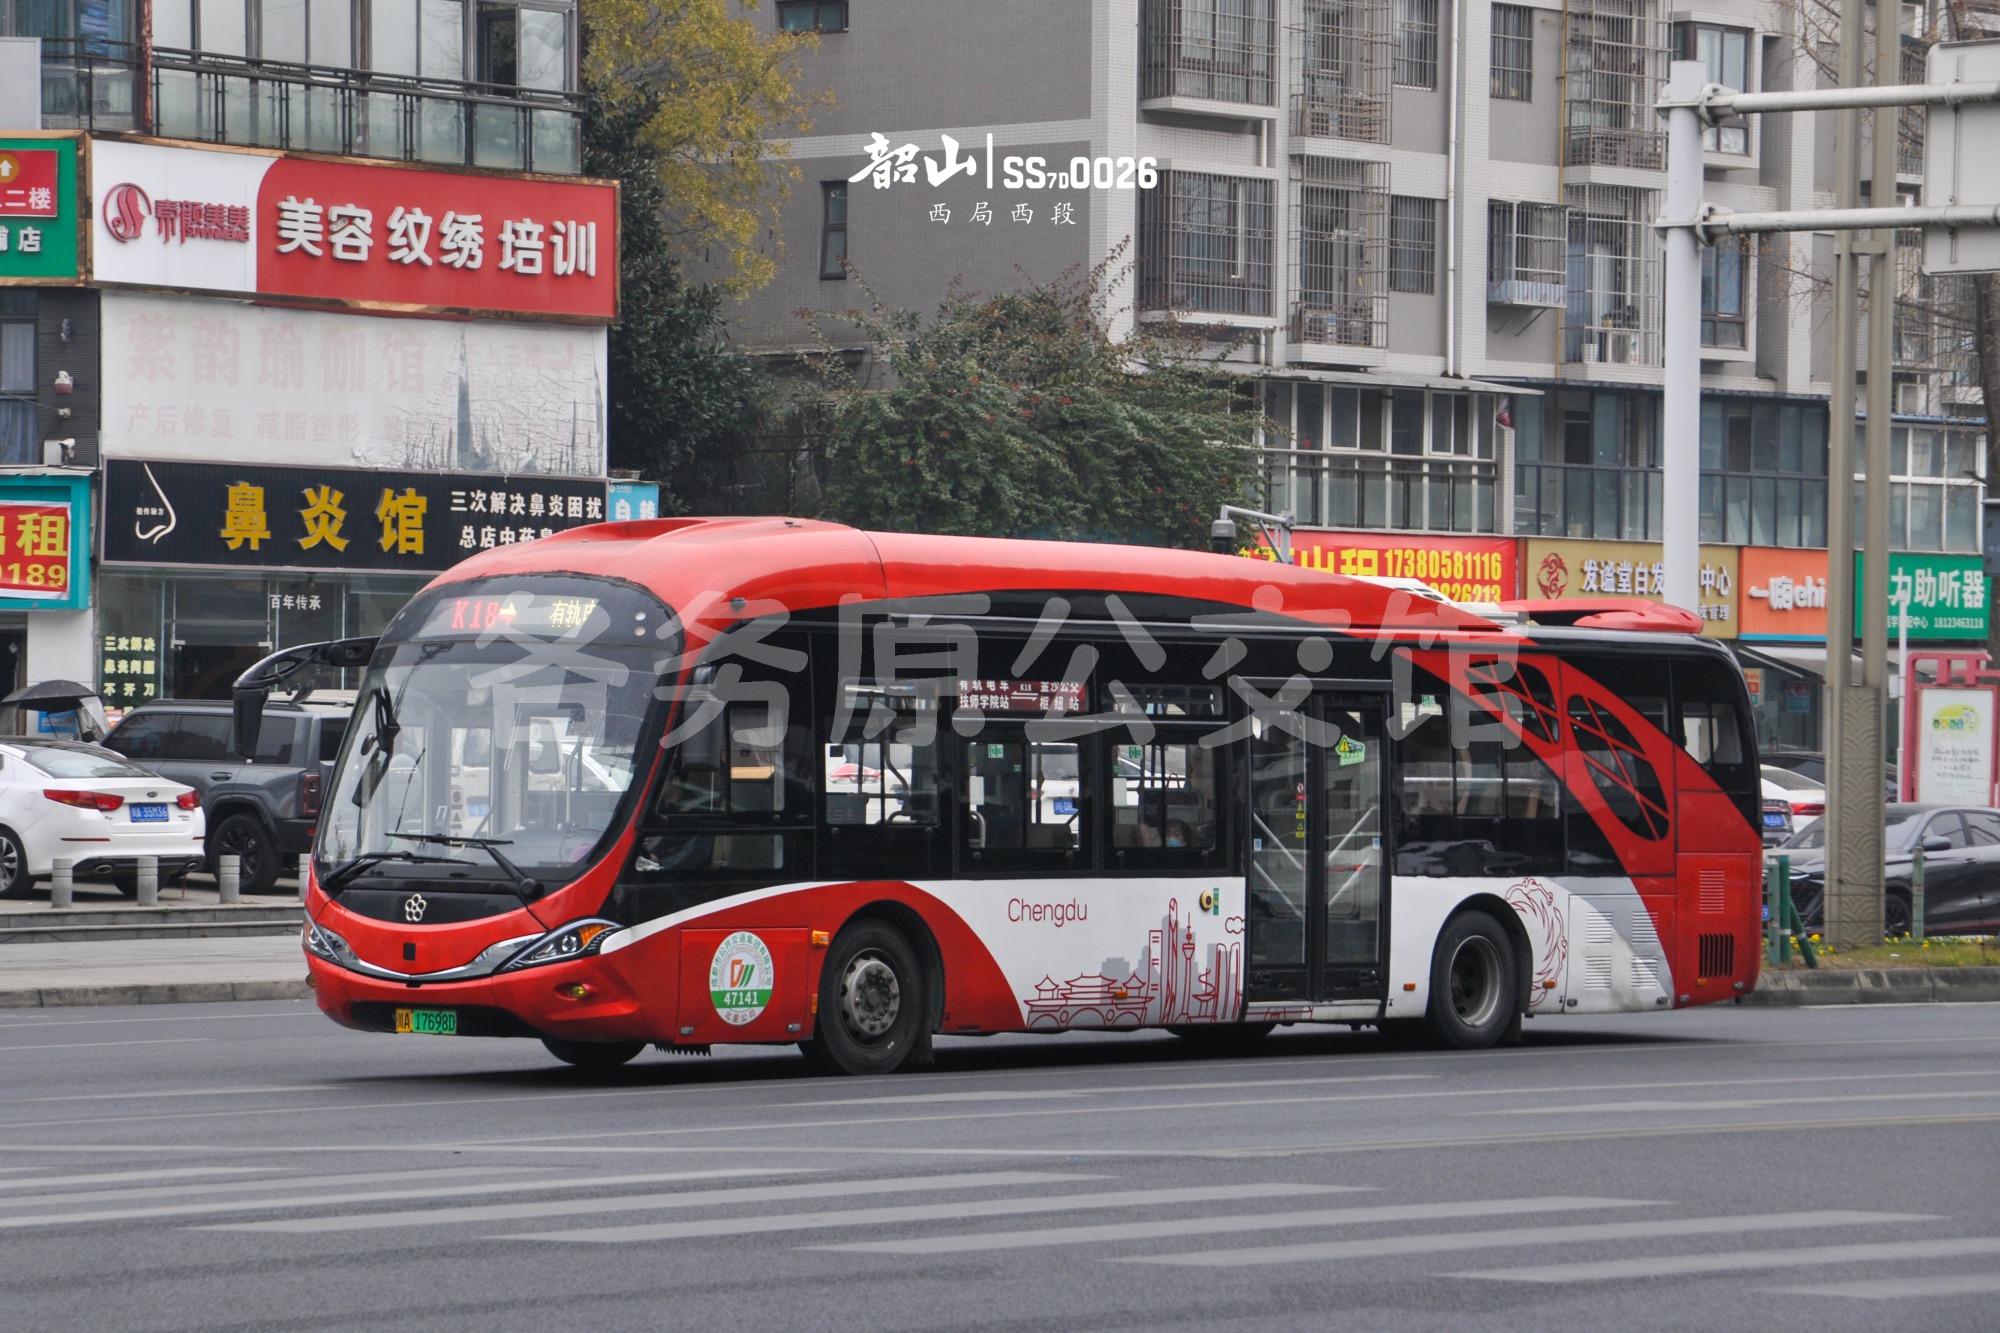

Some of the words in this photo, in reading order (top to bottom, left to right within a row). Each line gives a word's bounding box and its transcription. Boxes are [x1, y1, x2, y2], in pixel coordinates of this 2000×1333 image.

[0, 187, 51, 209] 二楼
[277, 195, 373, 261] 美容
[387, 206, 484, 269] 纹绣
[498, 218, 596, 277] 培训
[127, 312, 425, 395] 紫韵瑜伽馆
[127, 402, 234, 438] 产后修复
[450, 490, 603, 519] 三次解决鼻炎困扰
[220, 481, 428, 555] 鼻炎馆
[0, 513, 68, 556] 租
[0, 563, 66, 587] 189
[1385, 549, 1502, 580] 17380581116
[270, 594, 321, 610] 百年传承
[451, 600, 499, 628] K18
[104, 635, 155, 651] 三次解决
[103, 682, 155, 697] 不开刀
[1020, 683, 1031, 691] K18
[959, 694, 1009, 709] 技师学院站
[1039, 696, 1079, 711] 枢纽站
[1008, 898, 1088, 927] Chengdu
[724, 991, 759, 1005] 47141
